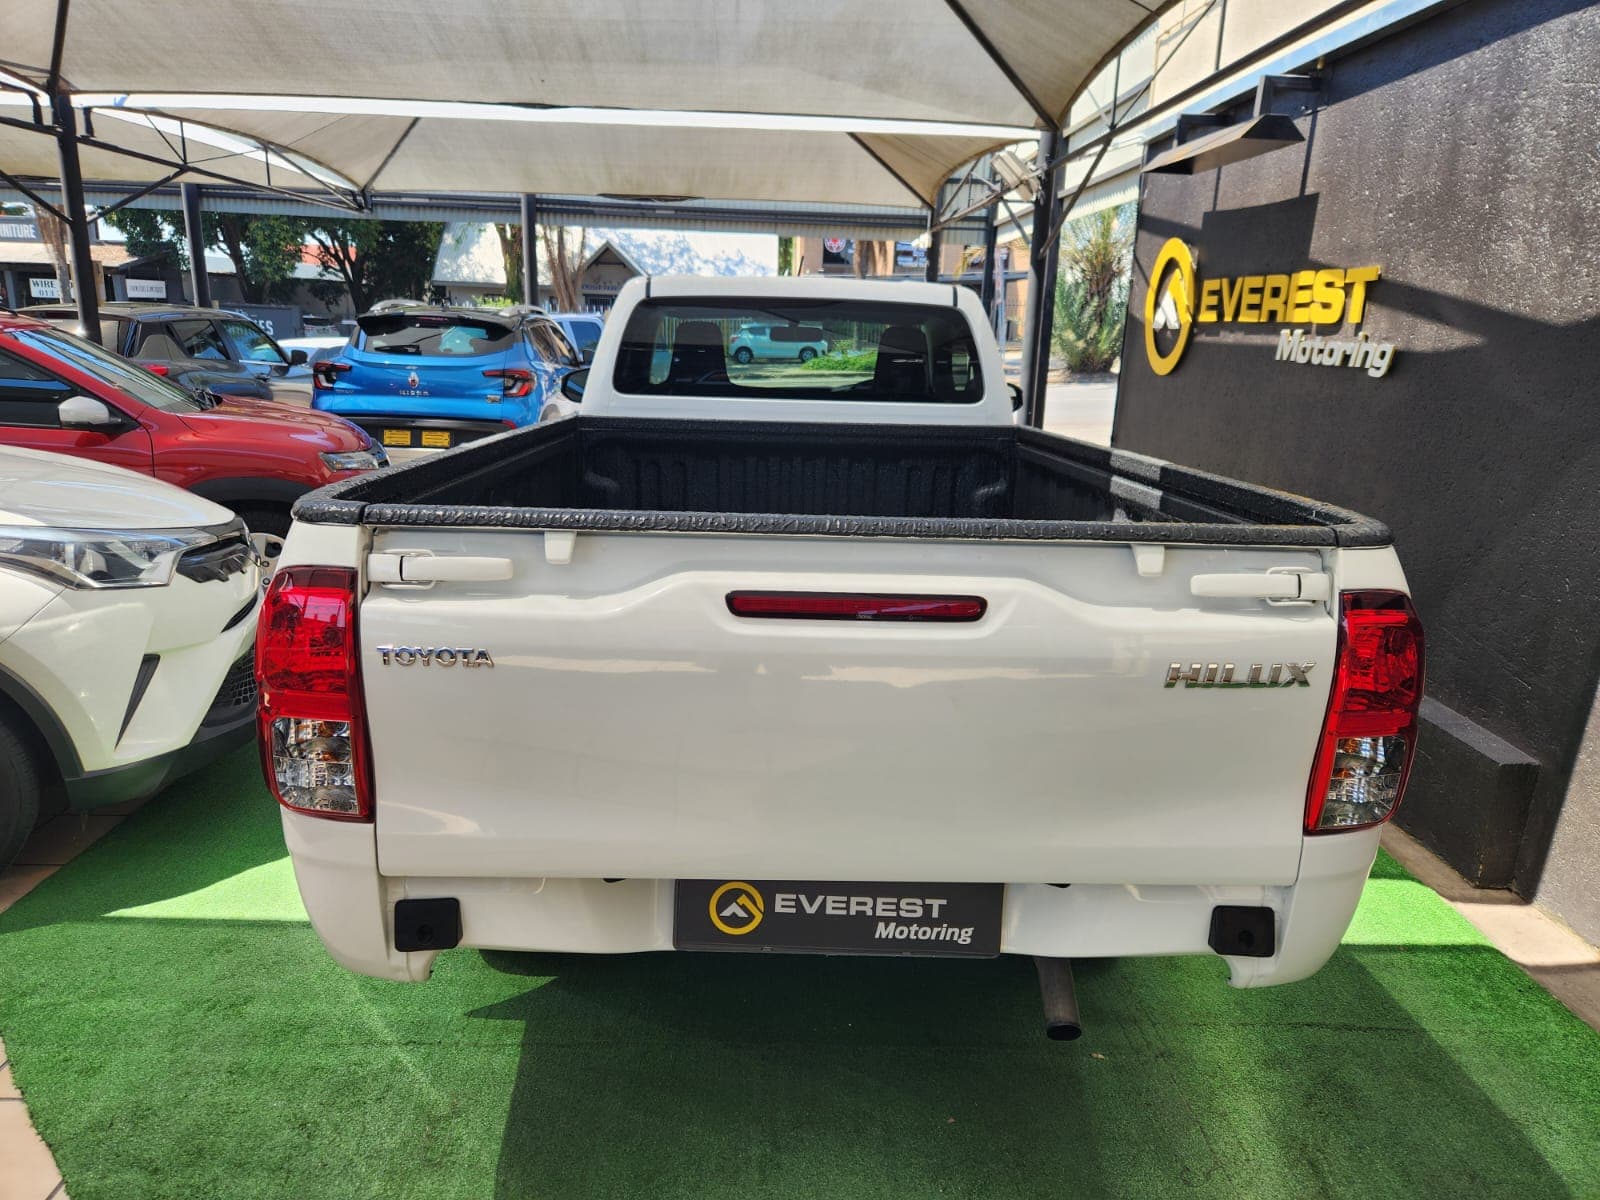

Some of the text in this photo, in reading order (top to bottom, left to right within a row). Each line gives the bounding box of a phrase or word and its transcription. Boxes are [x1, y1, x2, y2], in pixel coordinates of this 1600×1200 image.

[31, 279, 57, 289] WIRE
[1198, 266, 1381, 324] EVEREST
[1275, 328, 1397, 378] Motoring
[376, 644, 495, 669] TOYOTA
[1164, 660, 1317, 689] HILUX
[774, 893, 948, 919] EVEREST
[874, 921, 974, 945] Motoring
